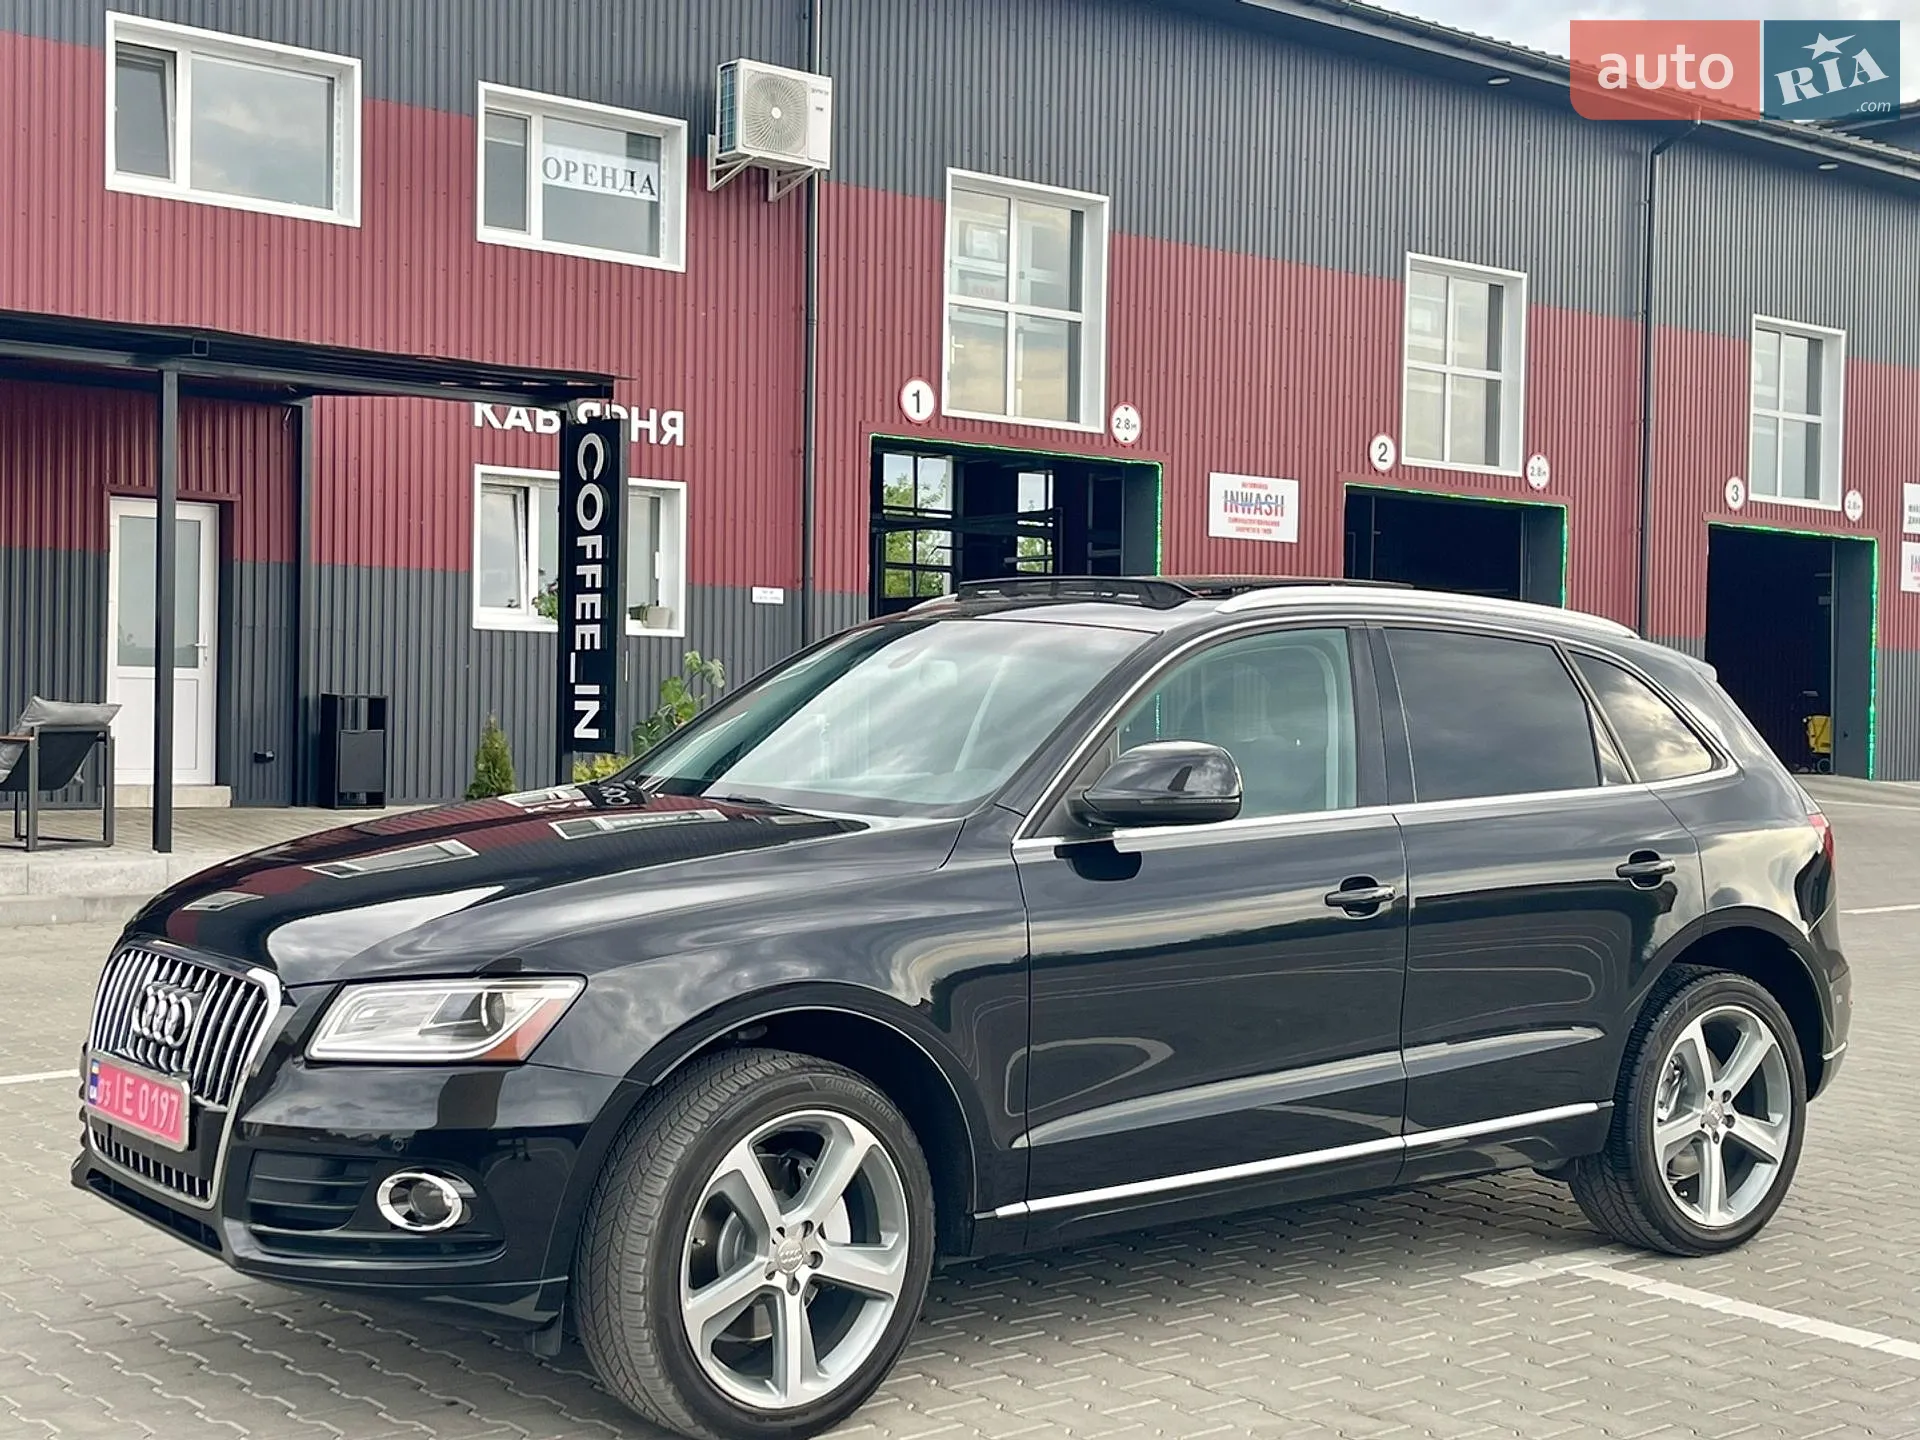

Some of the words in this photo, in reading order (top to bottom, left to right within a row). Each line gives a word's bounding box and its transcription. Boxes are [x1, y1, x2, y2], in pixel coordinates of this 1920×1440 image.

[541, 156, 657, 197] ОРЕНДА
[911, 389, 921, 413] 1
[1378, 442, 1388, 462] 2
[1223, 489, 1284, 518] INWASH
[1731, 484, 1739, 502] 3
[139, 1083, 179, 1133] 0197
